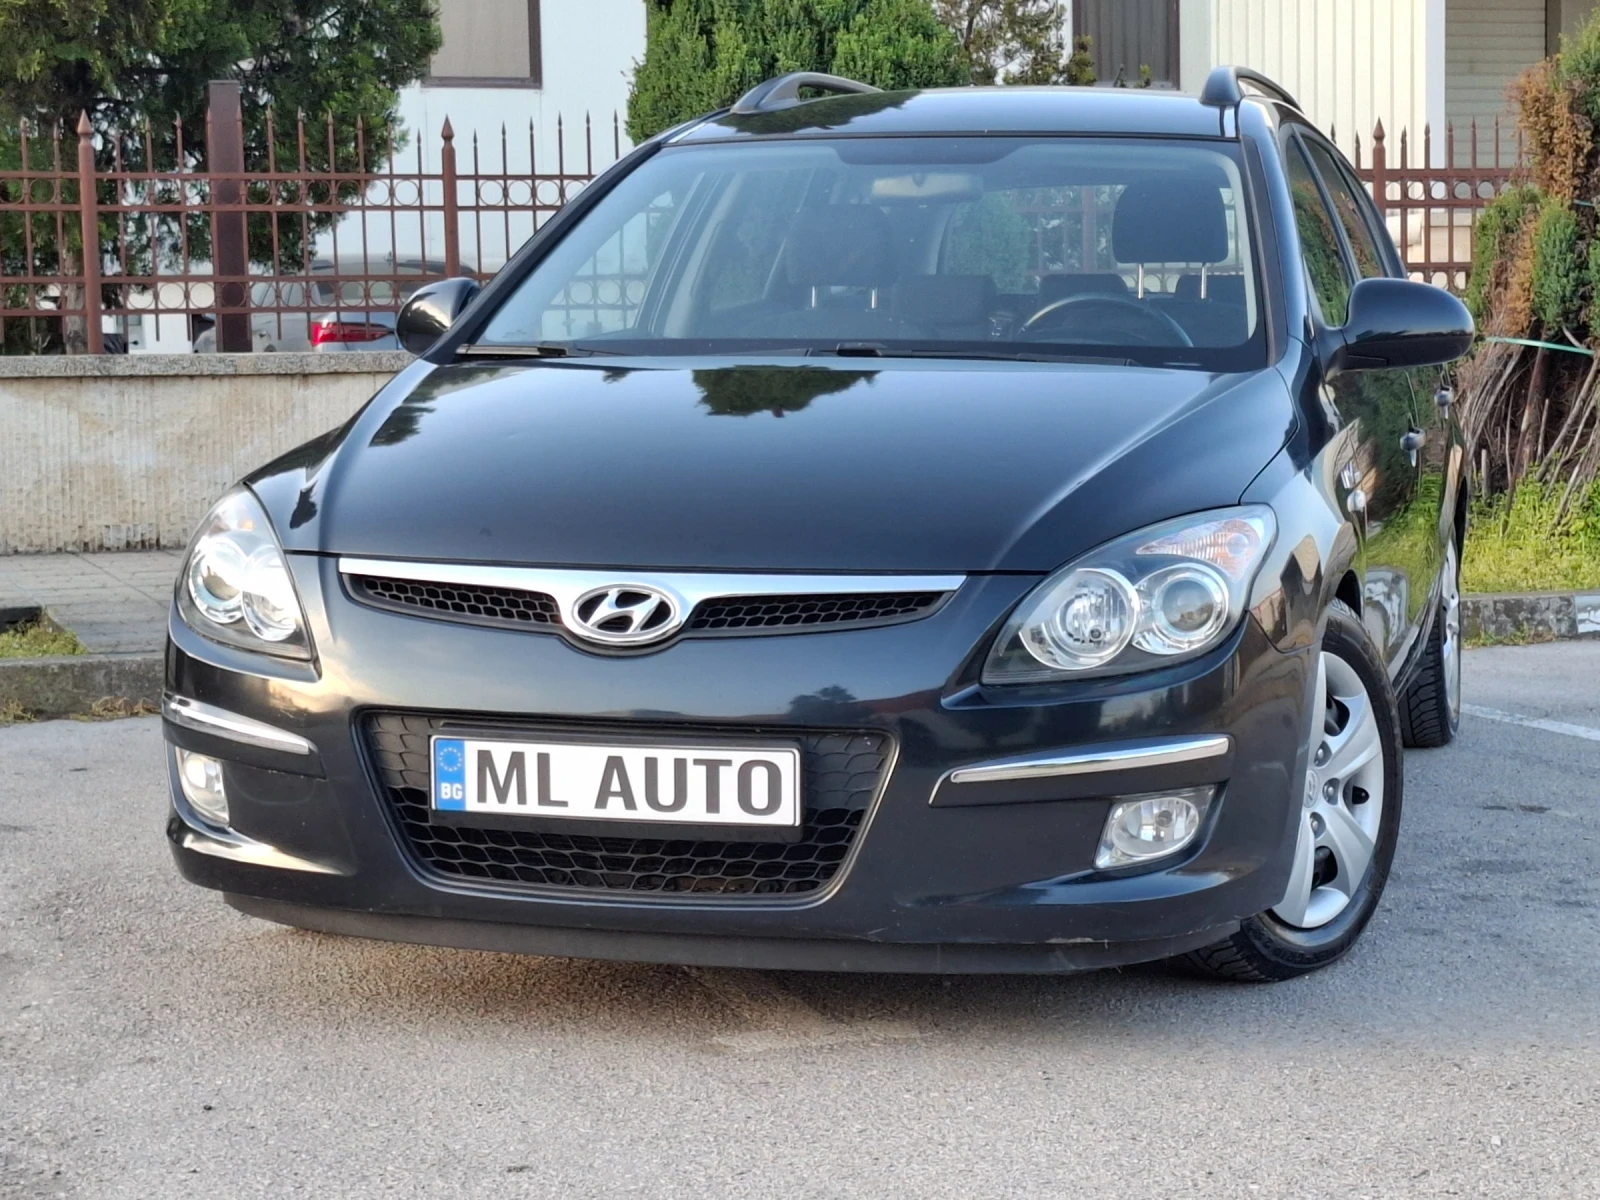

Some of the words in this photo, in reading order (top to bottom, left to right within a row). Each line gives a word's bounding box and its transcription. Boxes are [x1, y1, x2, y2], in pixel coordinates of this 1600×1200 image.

[439, 782, 463, 800] BG
[476, 749, 569, 808] ML
[593, 754, 783, 817] AUTO
